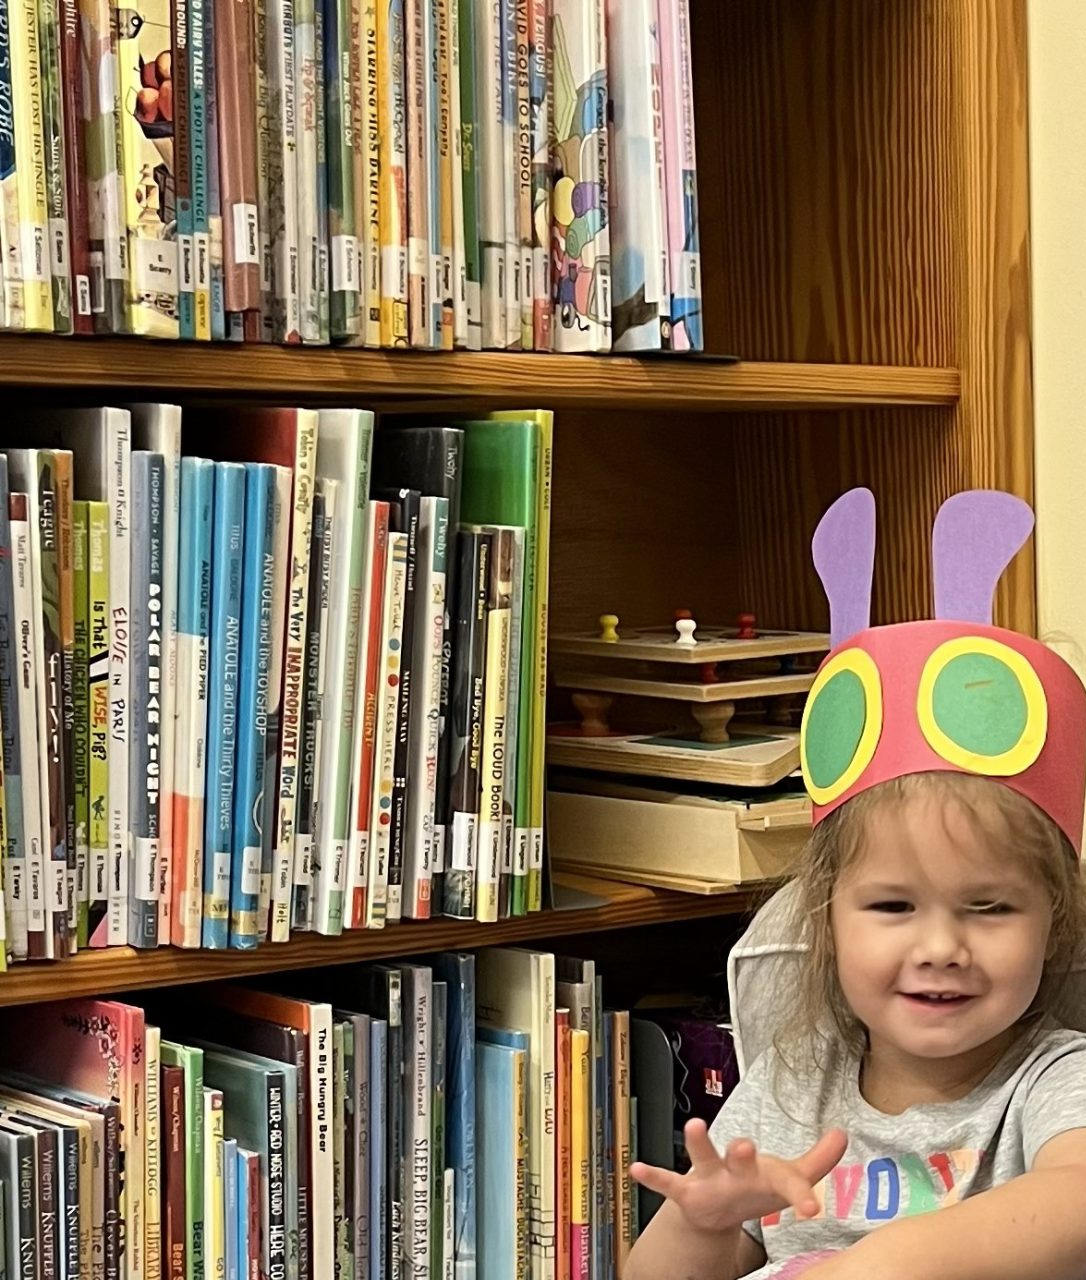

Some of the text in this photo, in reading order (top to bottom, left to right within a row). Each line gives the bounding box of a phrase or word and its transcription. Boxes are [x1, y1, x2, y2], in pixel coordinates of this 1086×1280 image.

[193, 12, 202, 47] FAIRY
[194, 51, 203, 89] TALES:
[368, 29, 376, 106] STARRING
[23, 4, 45, 207] JESTER HAS LOST HIS JINGLE
[518, 44, 531, 194] GOES TO SCHOOL.
[598, 138, 607, 156] the
[195, 155, 204, 223] CHALLENGE
[599, 158, 608, 197] Terrible
[115, 429, 127, 486] Thompson
[446, 447, 458, 479] Twohy
[40, 490, 54, 548] Teague
[114, 499, 127, 537] Knight
[151, 467, 160, 574] THOMPSON SAVAGE
[231, 524, 240, 549] TITUS
[436, 516, 447, 558] Twohy
[73, 521, 84, 570] Thomas
[92, 521, 105, 572] Thomas
[200, 560, 209, 609] ANATOLE
[255, 553, 273, 735] ANATOLE and the TOYSHOP
[433, 616, 444, 649] OOPS
[22, 661, 32, 688] Game
[91, 602, 108, 761] Is That WISE, Pig?
[112, 608, 128, 742] ELOISE IN PARIS
[198, 649, 207, 670] PIED
[307, 631, 320, 711] MONSTER
[62, 650, 74, 729] History of Me
[74, 620, 88, 797] THE CHICKEN WHO COULDN'T
[198, 674, 206, 700] PIPER
[281, 588, 304, 798] The Very INAPPROPRIATE Word
[219, 616, 239, 830] ANATOLE and the Thirty Thieves
[385, 696, 394, 733] PRESS
[427, 709, 439, 751] QUICK
[304, 721, 316, 790] TRUCKS!
[489, 716, 504, 822] The LOUD Book!
[276, 903, 287, 923] Holt
[416, 996, 427, 1033] Wright
[147, 1060, 158, 1122] WILLIAMS
[269, 1087, 282, 1121] WINTER
[317, 1029, 328, 1152] The Big Hungry Bear
[359, 1082, 368, 1112] Wood
[417, 1052, 426, 1116] Hillenbrand
[544, 1108, 554, 1134] LULU
[21, 1156, 32, 1208] Willems
[42, 1150, 54, 1201] Willems
[68, 1143, 78, 1190] Willems
[147, 1139, 158, 1196] KELLOGG
[270, 1130, 283, 1215] RED NOSE STUDIO
[413, 1139, 428, 1184] SLEEP,
[516, 1158, 525, 1211] MUSTACHE
[297, 1186, 307, 1223] LITTLE
[415, 1190, 428, 1214] BIG
[42, 1211, 56, 1278] KNUFFLE
[67, 1204, 80, 1268] KNUFFLE
[92, 1224, 104, 1252] The
[172, 1244, 185, 1272] Bear
[192, 1221, 204, 1256] Bear
[270, 1224, 285, 1257] HERE
[391, 1201, 402, 1280] Each Kindness
[412, 1219, 428, 1262] BEAR,
[581, 1226, 590, 1274] blanket
